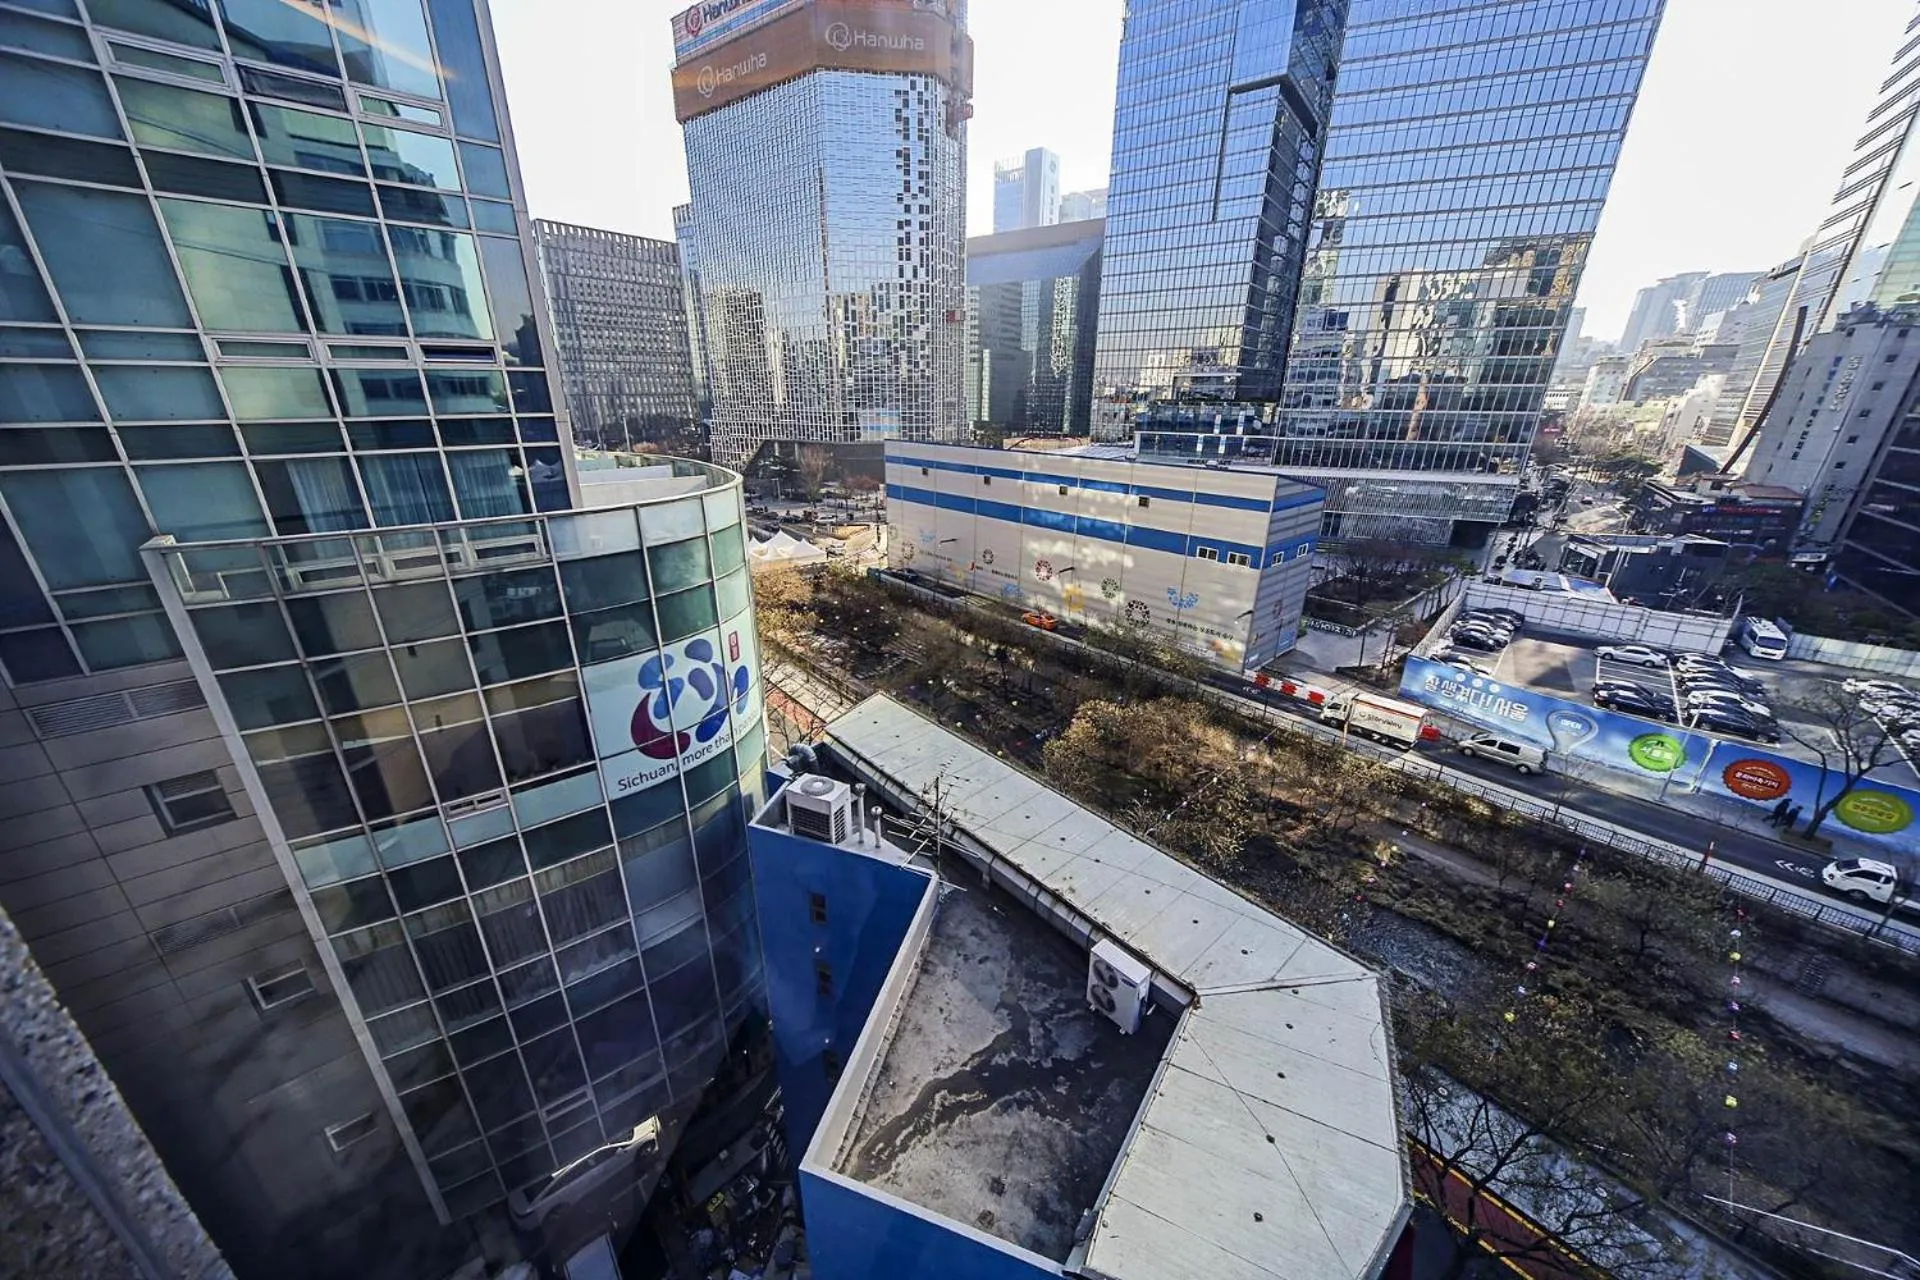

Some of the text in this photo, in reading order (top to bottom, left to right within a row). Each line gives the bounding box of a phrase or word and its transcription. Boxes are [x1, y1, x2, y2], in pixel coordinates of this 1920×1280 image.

[703, 0, 750, 23] Hanw
[853, 30, 925, 51] Hanwha
[715, 52, 767, 86] Hanwha
[682, 744, 714, 766] more
